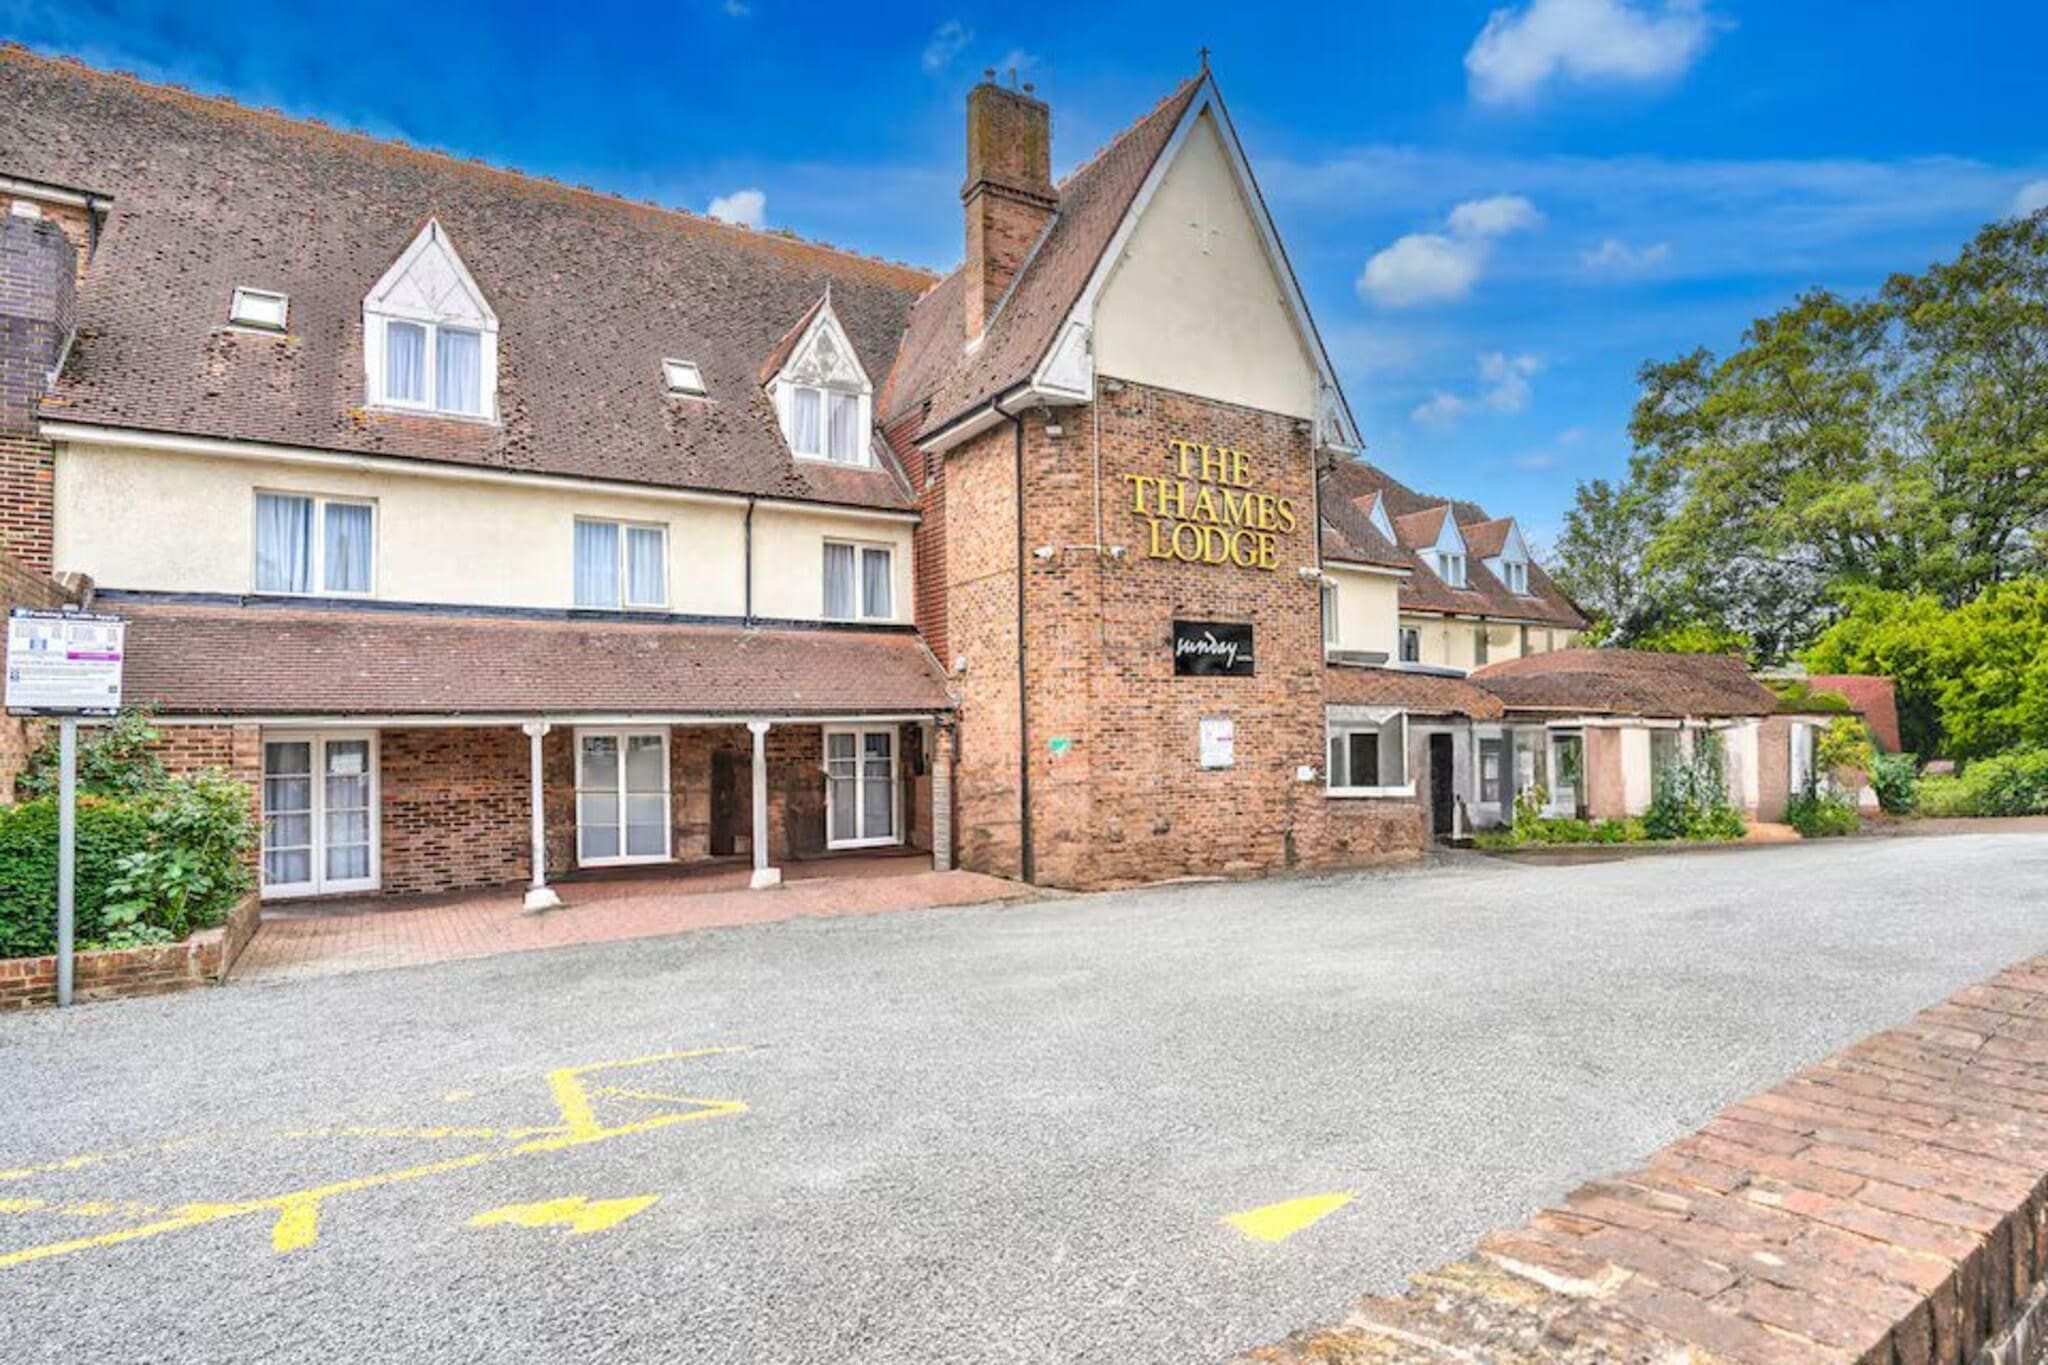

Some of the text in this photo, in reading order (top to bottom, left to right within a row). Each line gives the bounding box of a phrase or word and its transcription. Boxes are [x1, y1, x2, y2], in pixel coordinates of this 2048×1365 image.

[1170, 438, 1253, 488] THE
[1124, 473, 1296, 534] THAMES
[1147, 519, 1279, 570] LODGE
